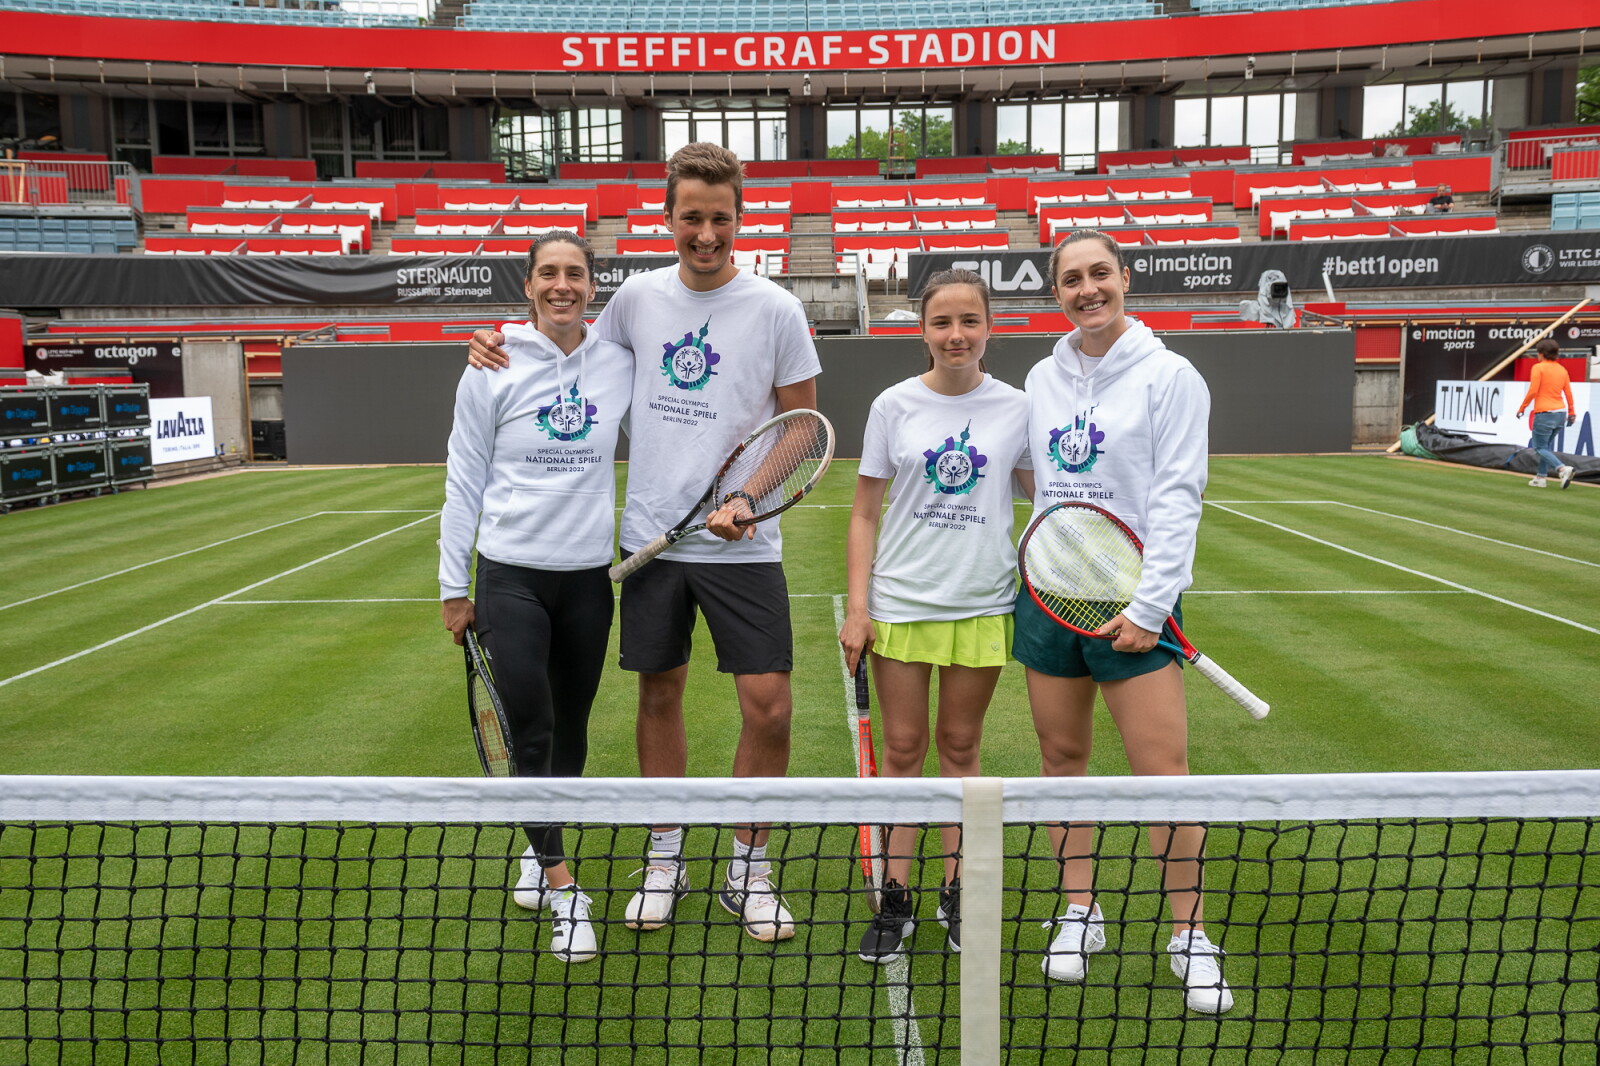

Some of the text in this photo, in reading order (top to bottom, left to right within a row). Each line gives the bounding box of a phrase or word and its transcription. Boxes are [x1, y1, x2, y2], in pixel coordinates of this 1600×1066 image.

[562, 29, 1057, 67] STEFFI-GRAF-STADION
[1559, 249, 1592, 260] LTTC
[1322, 255, 1439, 278] #bett1open
[396, 266, 492, 285] STERNAUTO
[1183, 272, 1232, 289] sports
[444, 287, 492, 297] Sternagel
[1443, 340, 1475, 350] sports
[94, 345, 157, 365] octagon
[658, 395, 709, 408] SPECIAL OLYMPICS
[1441, 383, 1500, 424] TITANIC
[649, 402, 718, 419] NATIONALE SPIELE
[157, 411, 205, 439] LAVAZZA
[663, 415, 682, 423] BERLIN
[525, 456, 602, 464] NATIONALE SPIELE
[1041, 490, 1114, 499] NATIONALE SPIELE
[947, 504, 977, 512] OLYMPICS
[913, 511, 986, 524] NATIONALE SPIELE
[928, 521, 948, 529] BERLIN
